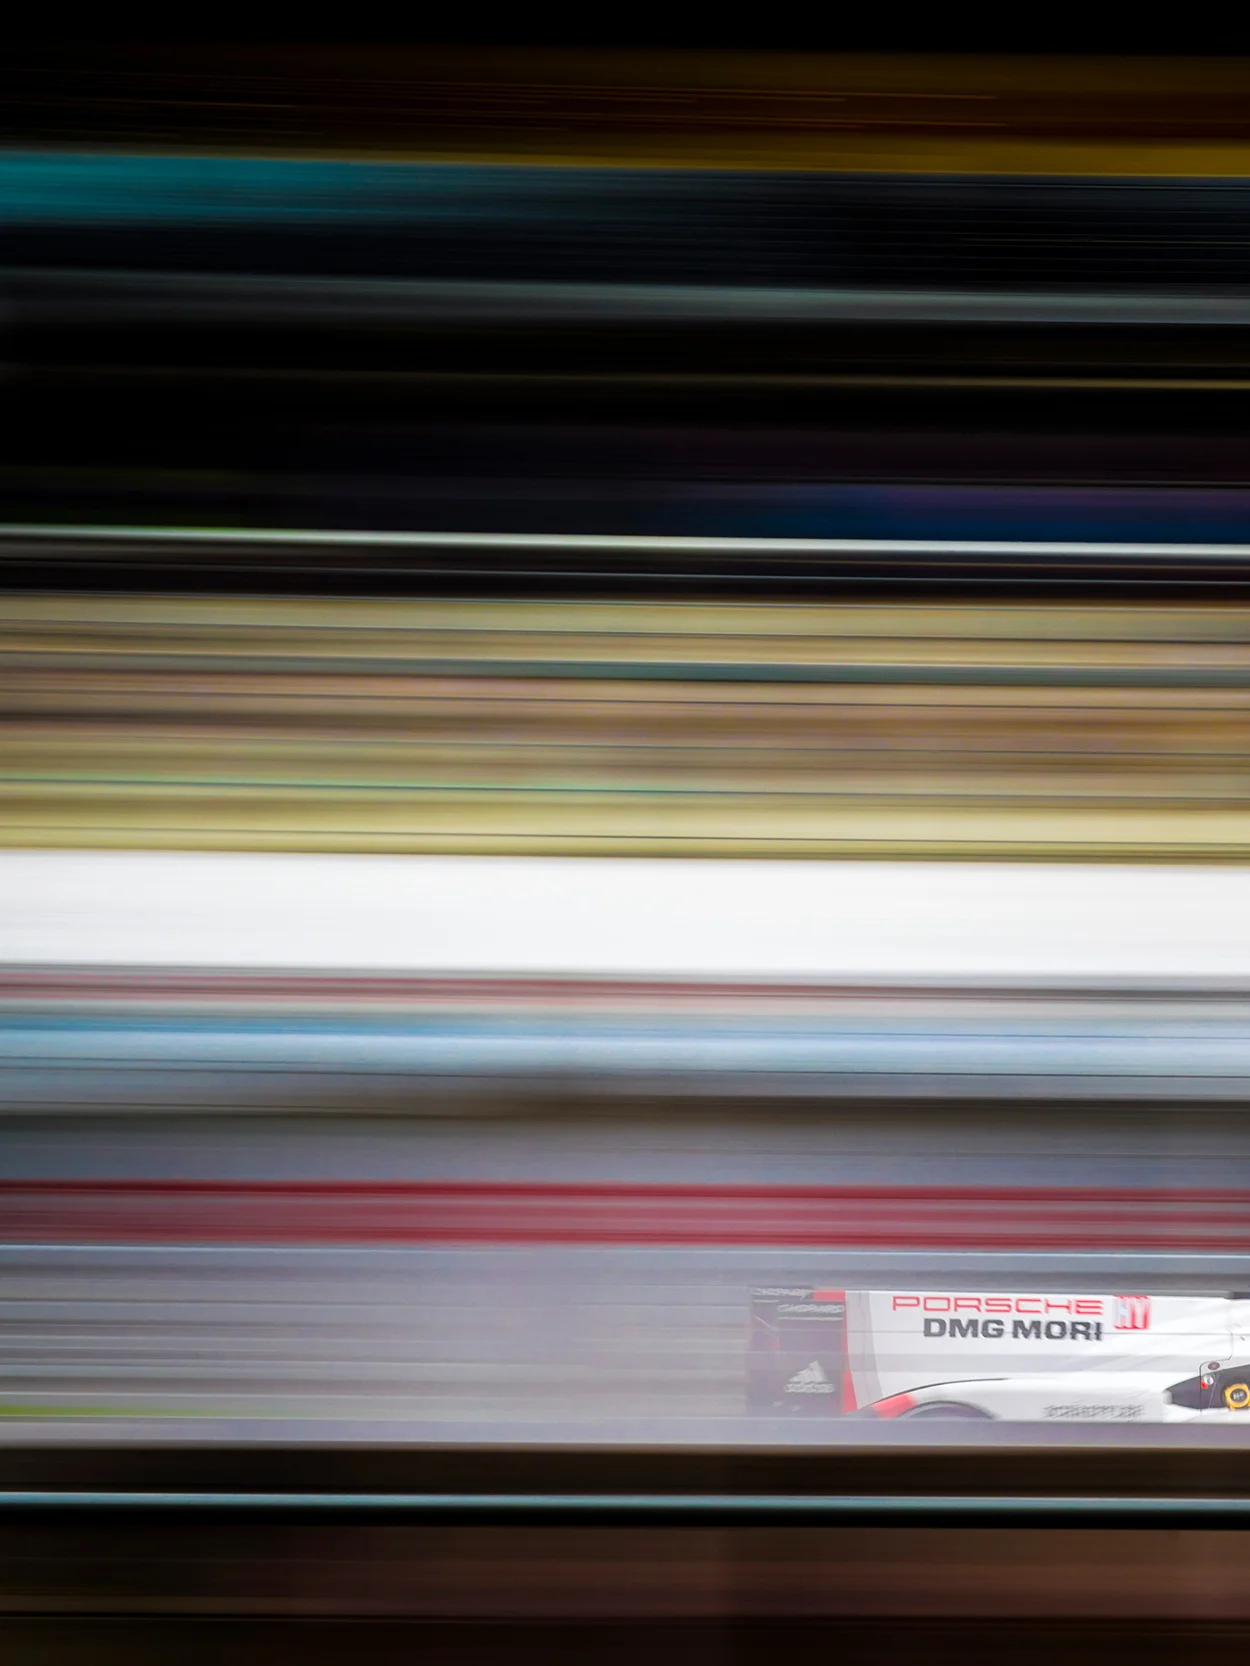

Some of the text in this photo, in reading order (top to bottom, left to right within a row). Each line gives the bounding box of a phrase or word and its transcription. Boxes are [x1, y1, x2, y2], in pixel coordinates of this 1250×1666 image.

[892, 1296, 1103, 1315] PORSCHE
[923, 1318, 1103, 1341] DMG MORI
